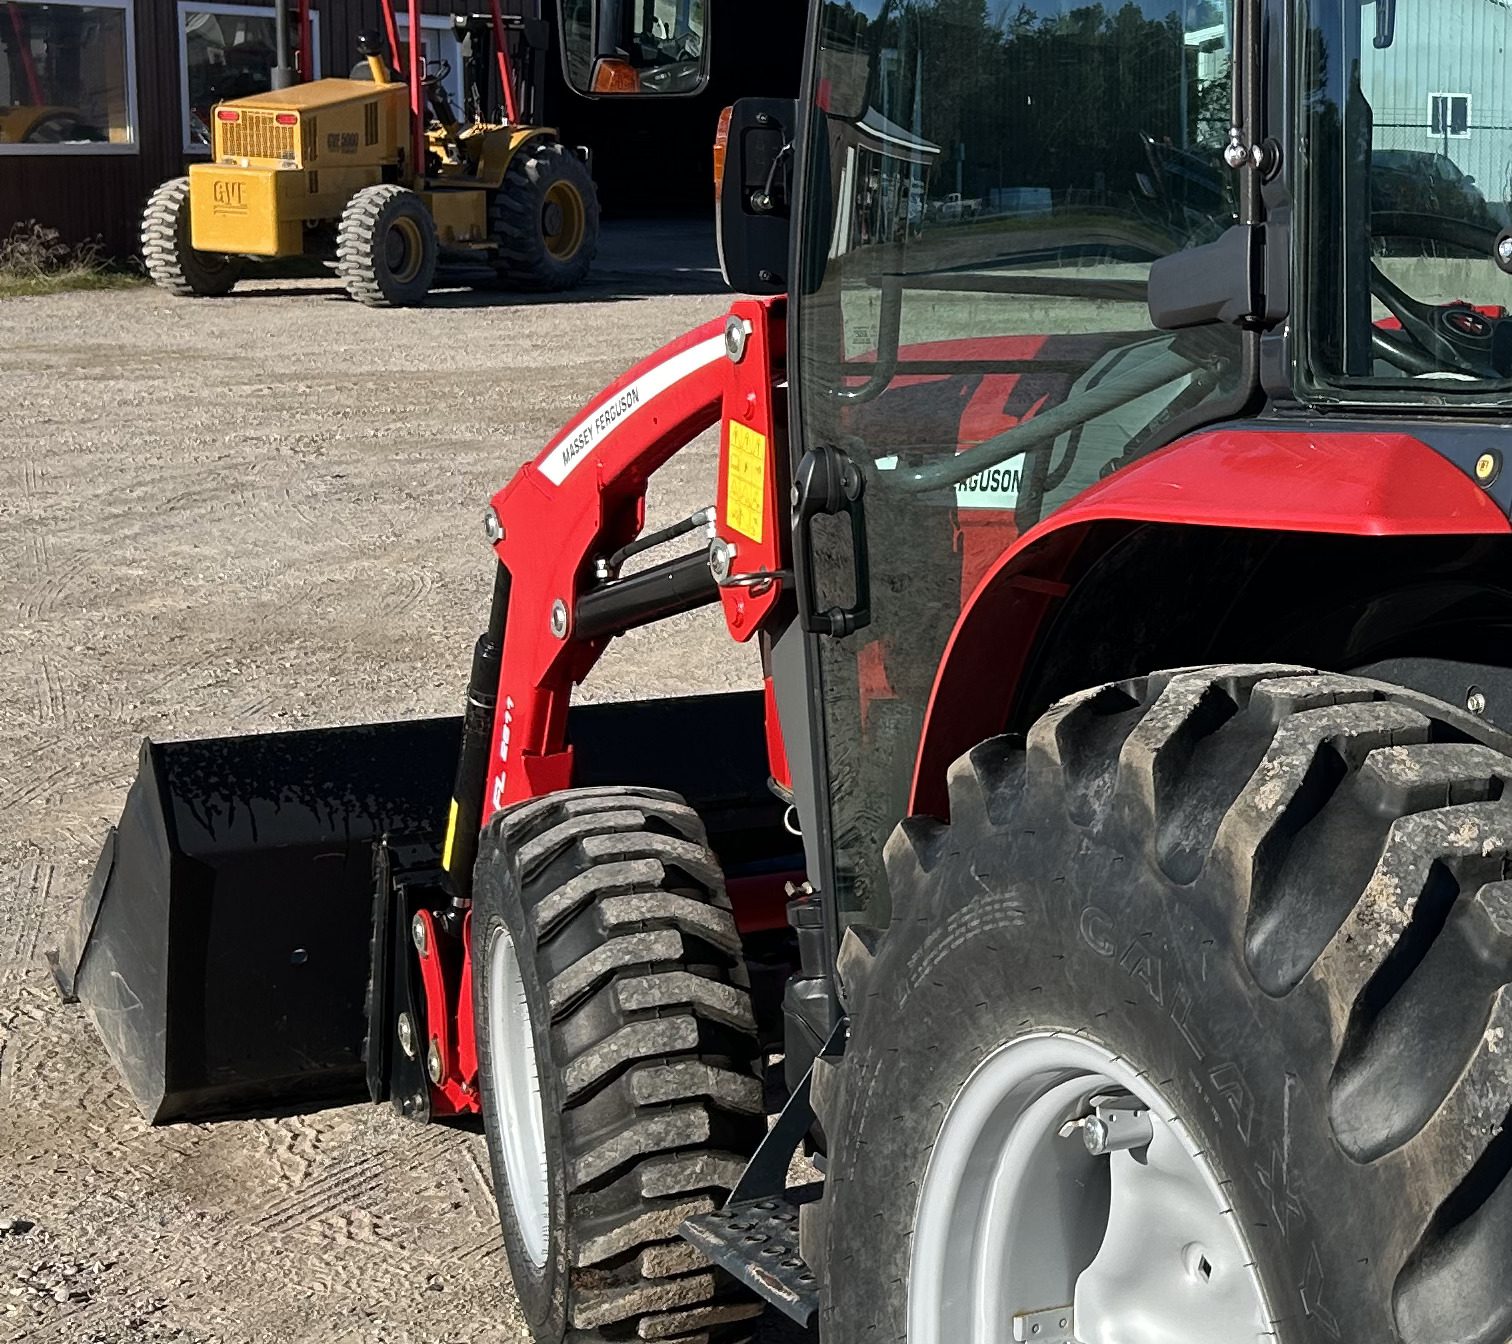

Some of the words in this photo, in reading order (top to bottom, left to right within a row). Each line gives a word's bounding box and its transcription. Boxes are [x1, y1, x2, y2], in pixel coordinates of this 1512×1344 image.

[562, 424, 594, 467] MASSEY
[595, 386, 640, 434] FERGUSON
[1080, 906, 1341, 1340] GALAXY
